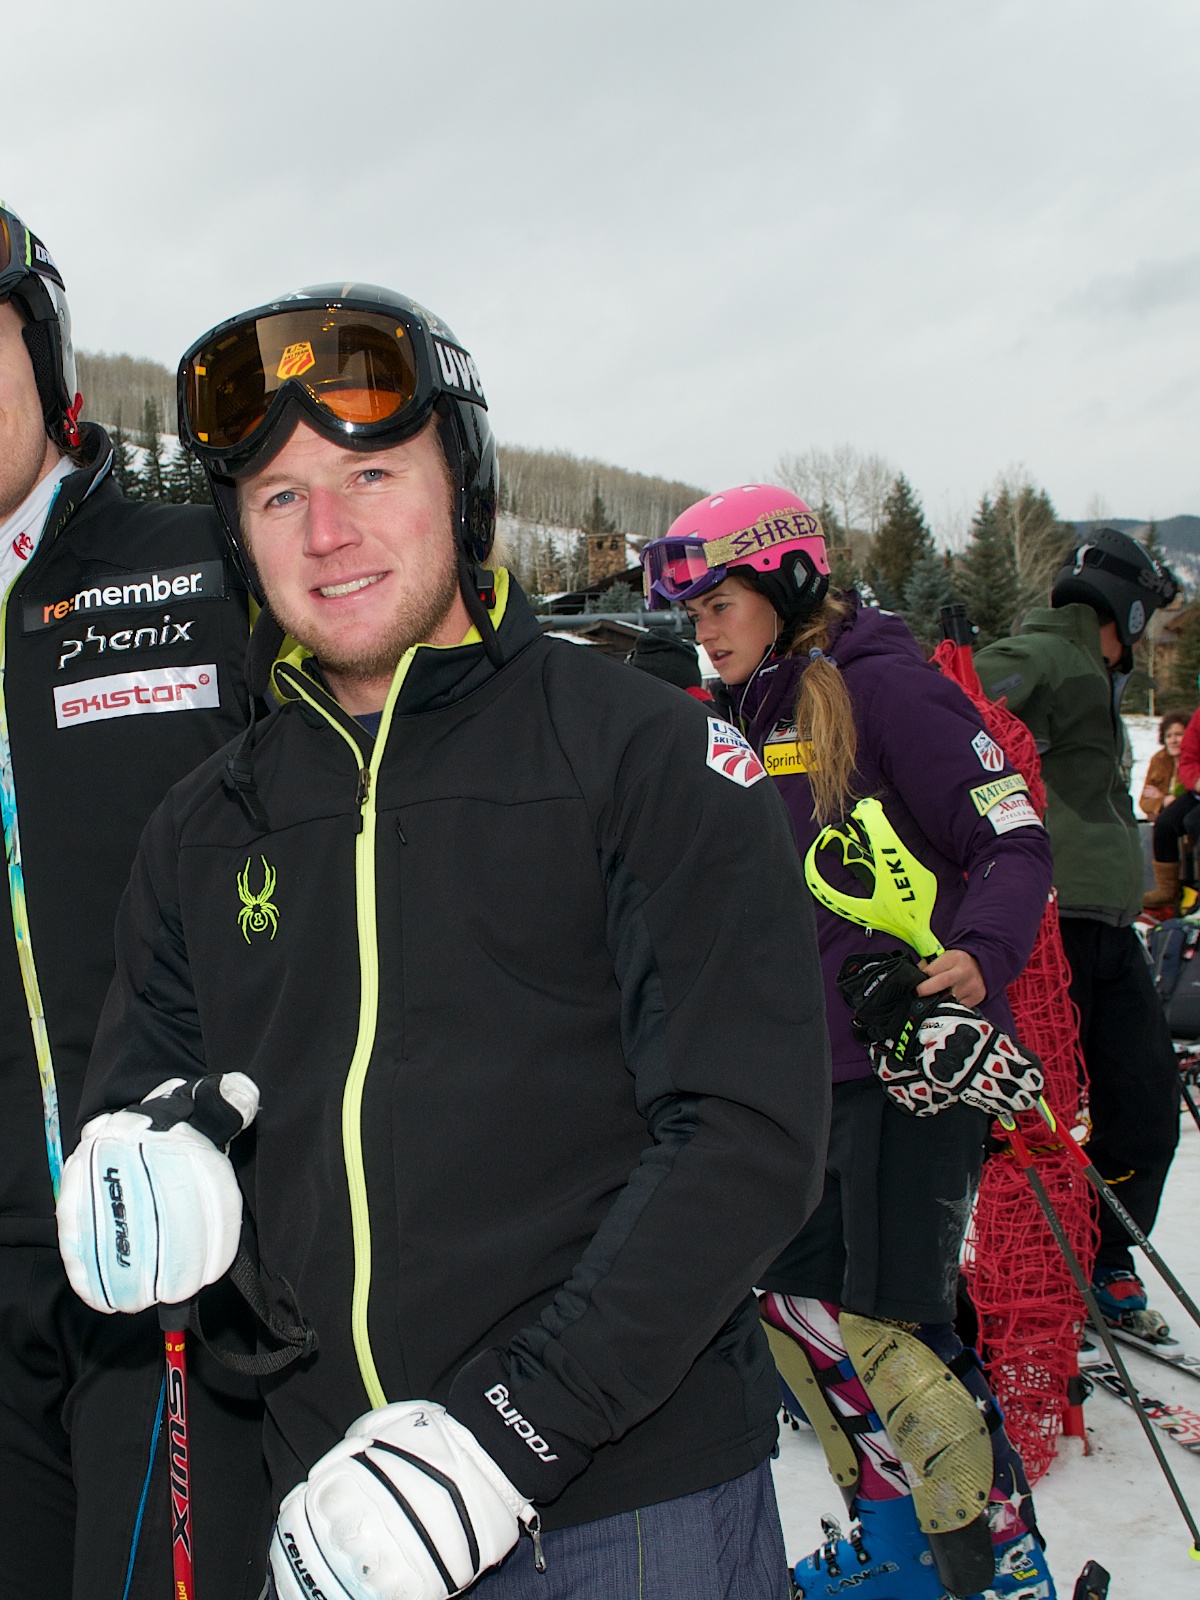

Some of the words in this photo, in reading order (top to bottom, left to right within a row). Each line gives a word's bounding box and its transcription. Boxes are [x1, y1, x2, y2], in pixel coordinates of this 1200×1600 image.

[730, 514, 817, 556] SHRED
[43, 573, 201, 623] re:member
[58, 615, 196, 669] phenix
[62, 683, 197, 718] skistar
[713, 722, 742, 739] US
[714, 736, 728, 744] SKI
[767, 753, 801, 771] Sprint
[975, 779, 1014, 811] NATURE
[881, 848, 916, 902] LEKI
[895, 1020, 913, 1062] LEKI
[103, 1167, 131, 1268] reusch
[1103, 1187, 1153, 1254] CARBON
[484, 1383, 559, 1463] racing
[166, 1358, 192, 1563] SWIX
[825, 1562, 900, 1596] LANE
